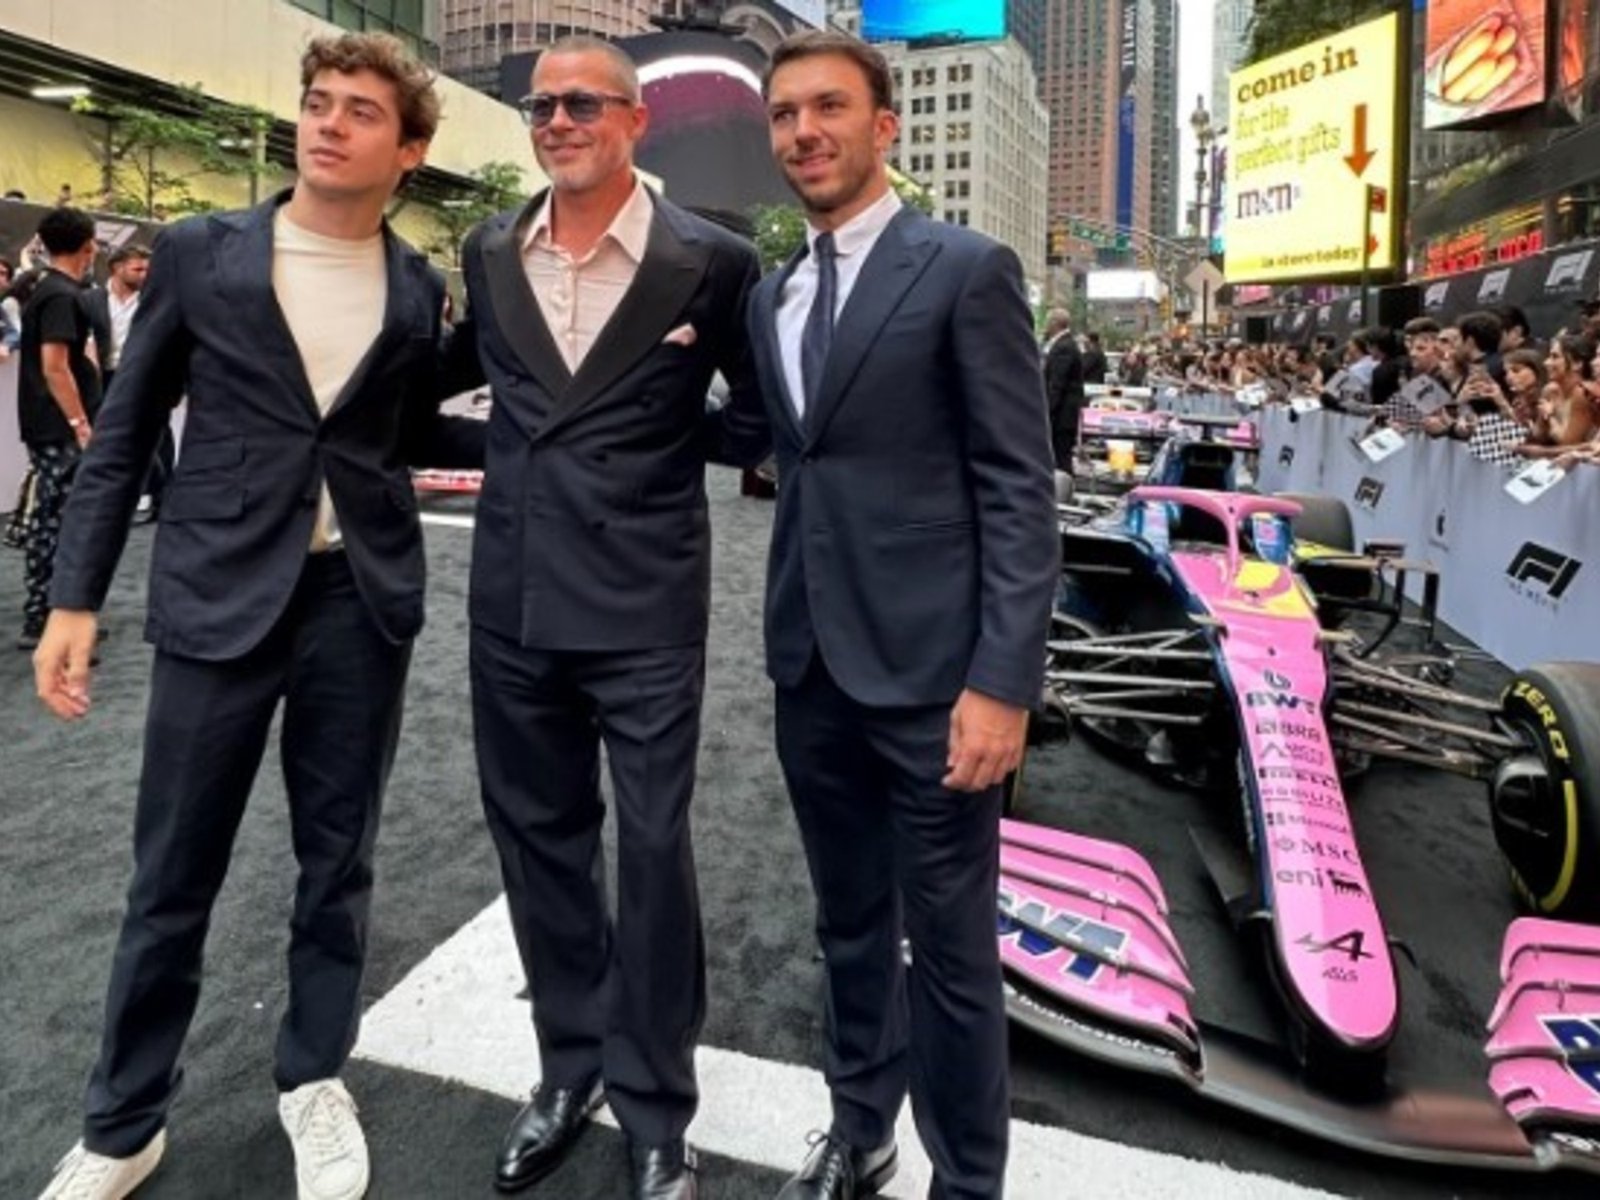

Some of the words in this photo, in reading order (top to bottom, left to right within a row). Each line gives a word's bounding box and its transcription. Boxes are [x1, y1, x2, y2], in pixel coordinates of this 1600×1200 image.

[1237, 61, 1317, 103] come
[1321, 45, 1359, 76] in
[1261, 102, 1289, 132] the
[1297, 122, 1342, 165] gifts
[1316, 245, 1361, 264] today
[1513, 680, 1570, 760] ZERO
[1301, 838, 1360, 866] MSC
[1276, 867, 1324, 888] eni
[997, 889, 1130, 985] WT
